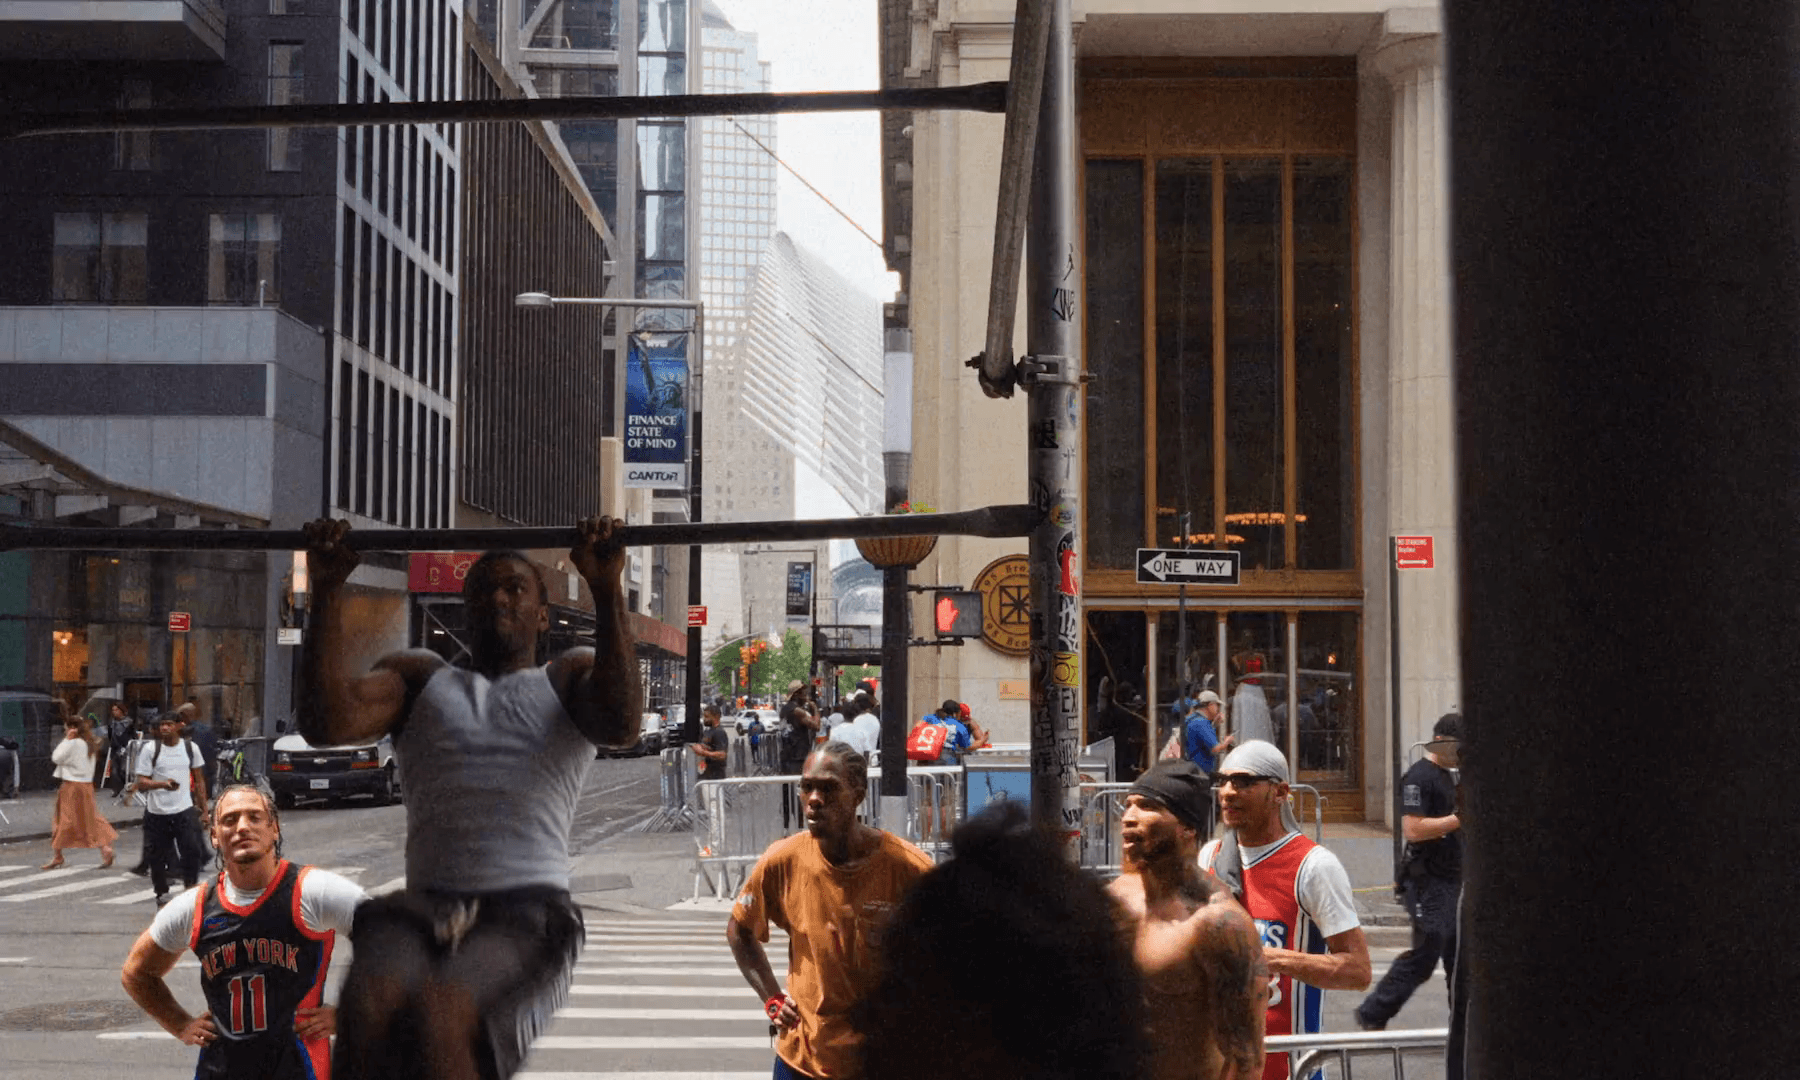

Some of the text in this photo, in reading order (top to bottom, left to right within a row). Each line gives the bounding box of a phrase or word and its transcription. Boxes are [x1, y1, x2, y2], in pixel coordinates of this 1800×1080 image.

[628, 415, 678, 425] FINANCE
[628, 427, 662, 437] STATE
[628, 438, 677, 449] OF MIND
[628, 471, 678, 481] CANTOR
[1153, 560, 1226, 574] ONE WAY
[916, 726, 938, 751] C21
[201, 938, 299, 981] NEW YORK
[227, 973, 268, 1034] 11
